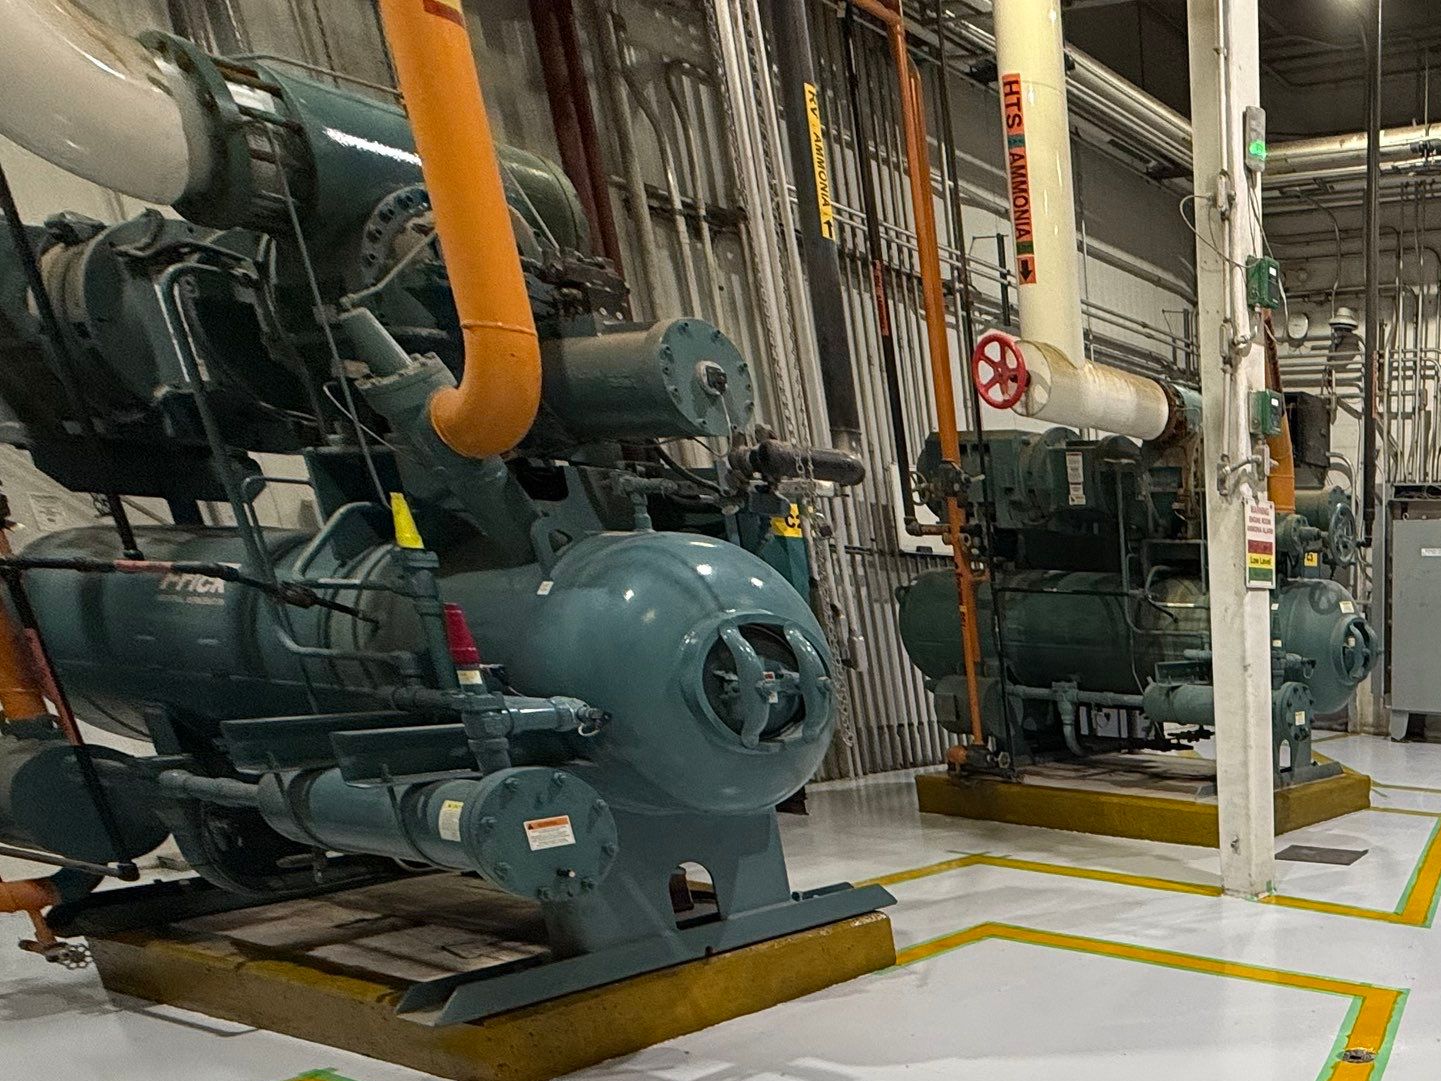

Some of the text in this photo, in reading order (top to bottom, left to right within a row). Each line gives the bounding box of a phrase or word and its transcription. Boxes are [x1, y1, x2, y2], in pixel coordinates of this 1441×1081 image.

[812, 132, 829, 207] AMMONIA
[1003, 79, 1032, 240] HTS AMMONIA
